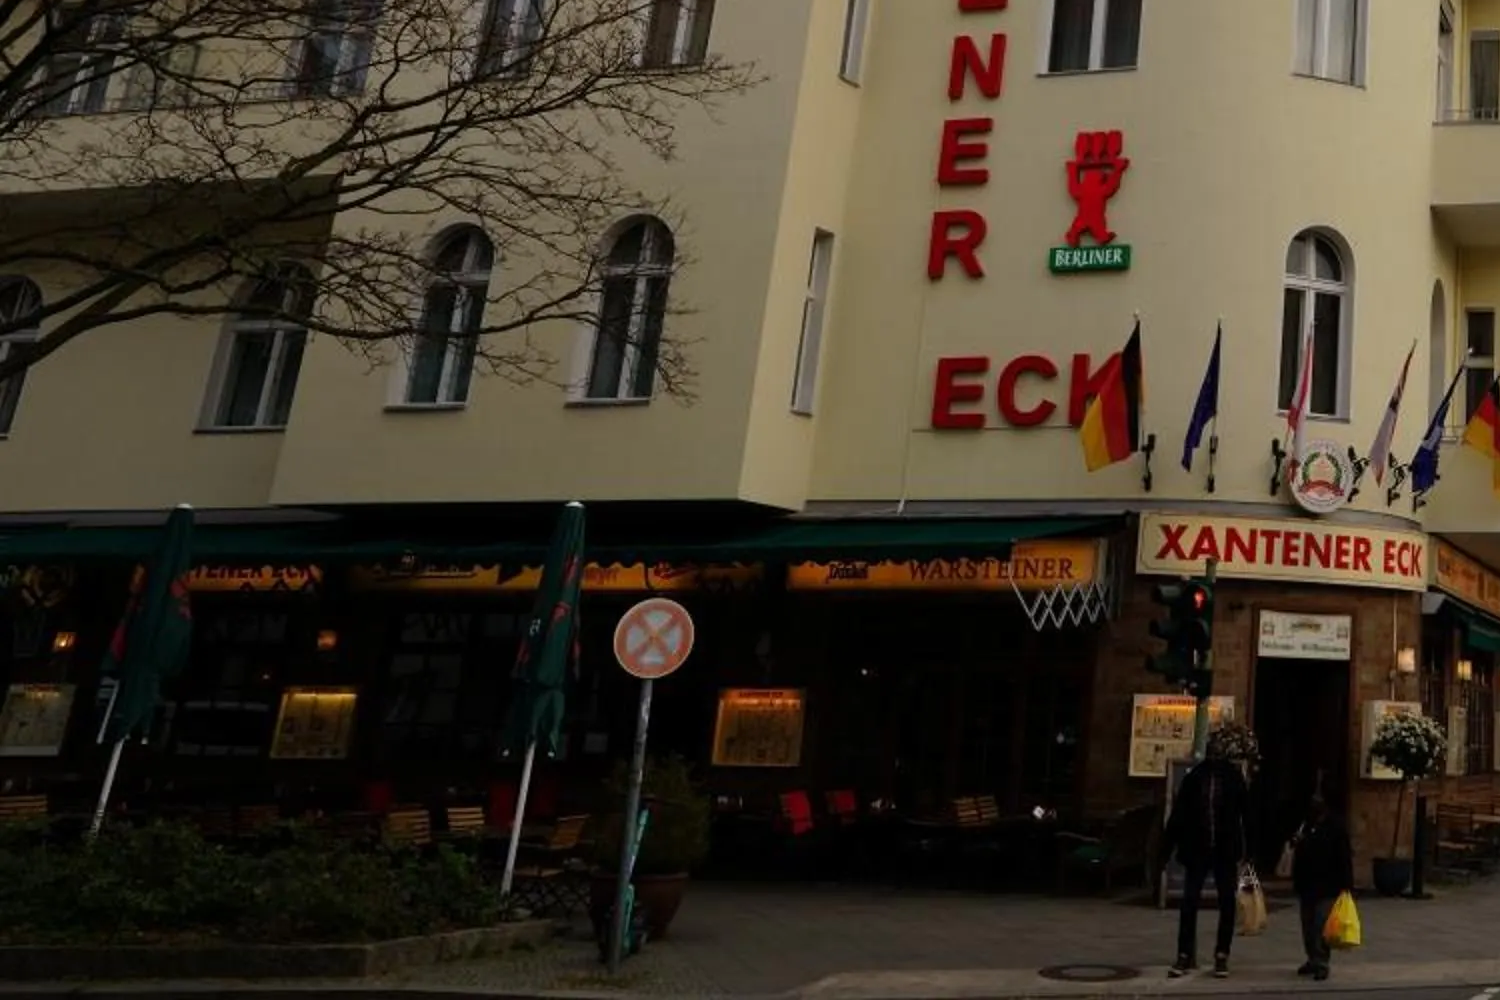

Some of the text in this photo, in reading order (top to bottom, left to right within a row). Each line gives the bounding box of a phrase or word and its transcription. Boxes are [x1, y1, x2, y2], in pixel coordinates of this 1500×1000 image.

[1054, 247, 1123, 267] BERLINER
[931, 352, 1123, 430] ECK
[908, 556, 1074, 581] WARSTEINER
[1154, 523, 1423, 578] XANTENER ECK
